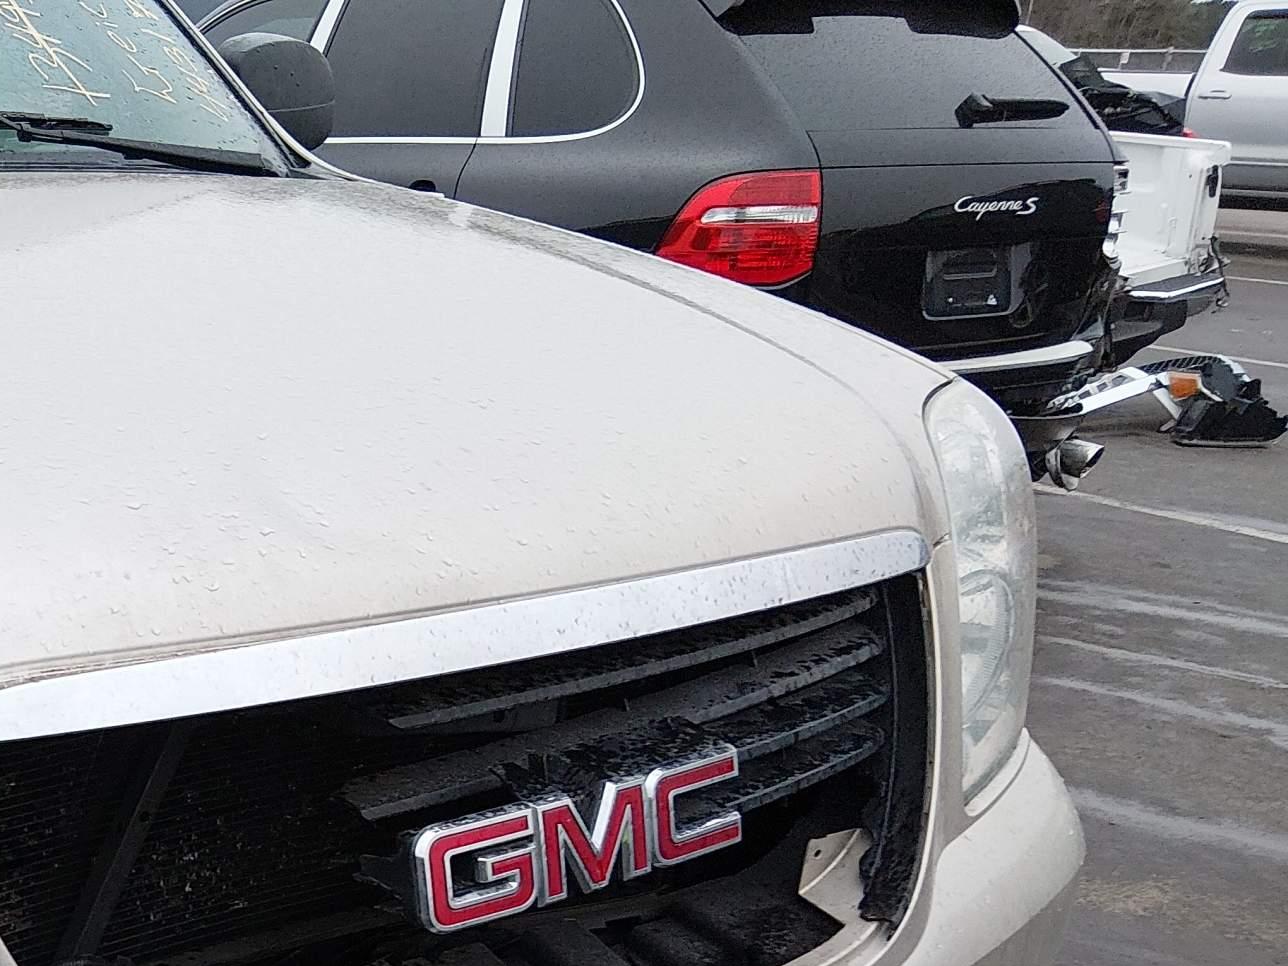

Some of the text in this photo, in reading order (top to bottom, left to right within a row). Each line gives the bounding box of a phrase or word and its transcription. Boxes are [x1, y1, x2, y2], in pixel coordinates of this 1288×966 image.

[953, 195, 1040, 221] Cayenne S
[415, 744, 743, 935] GMC
